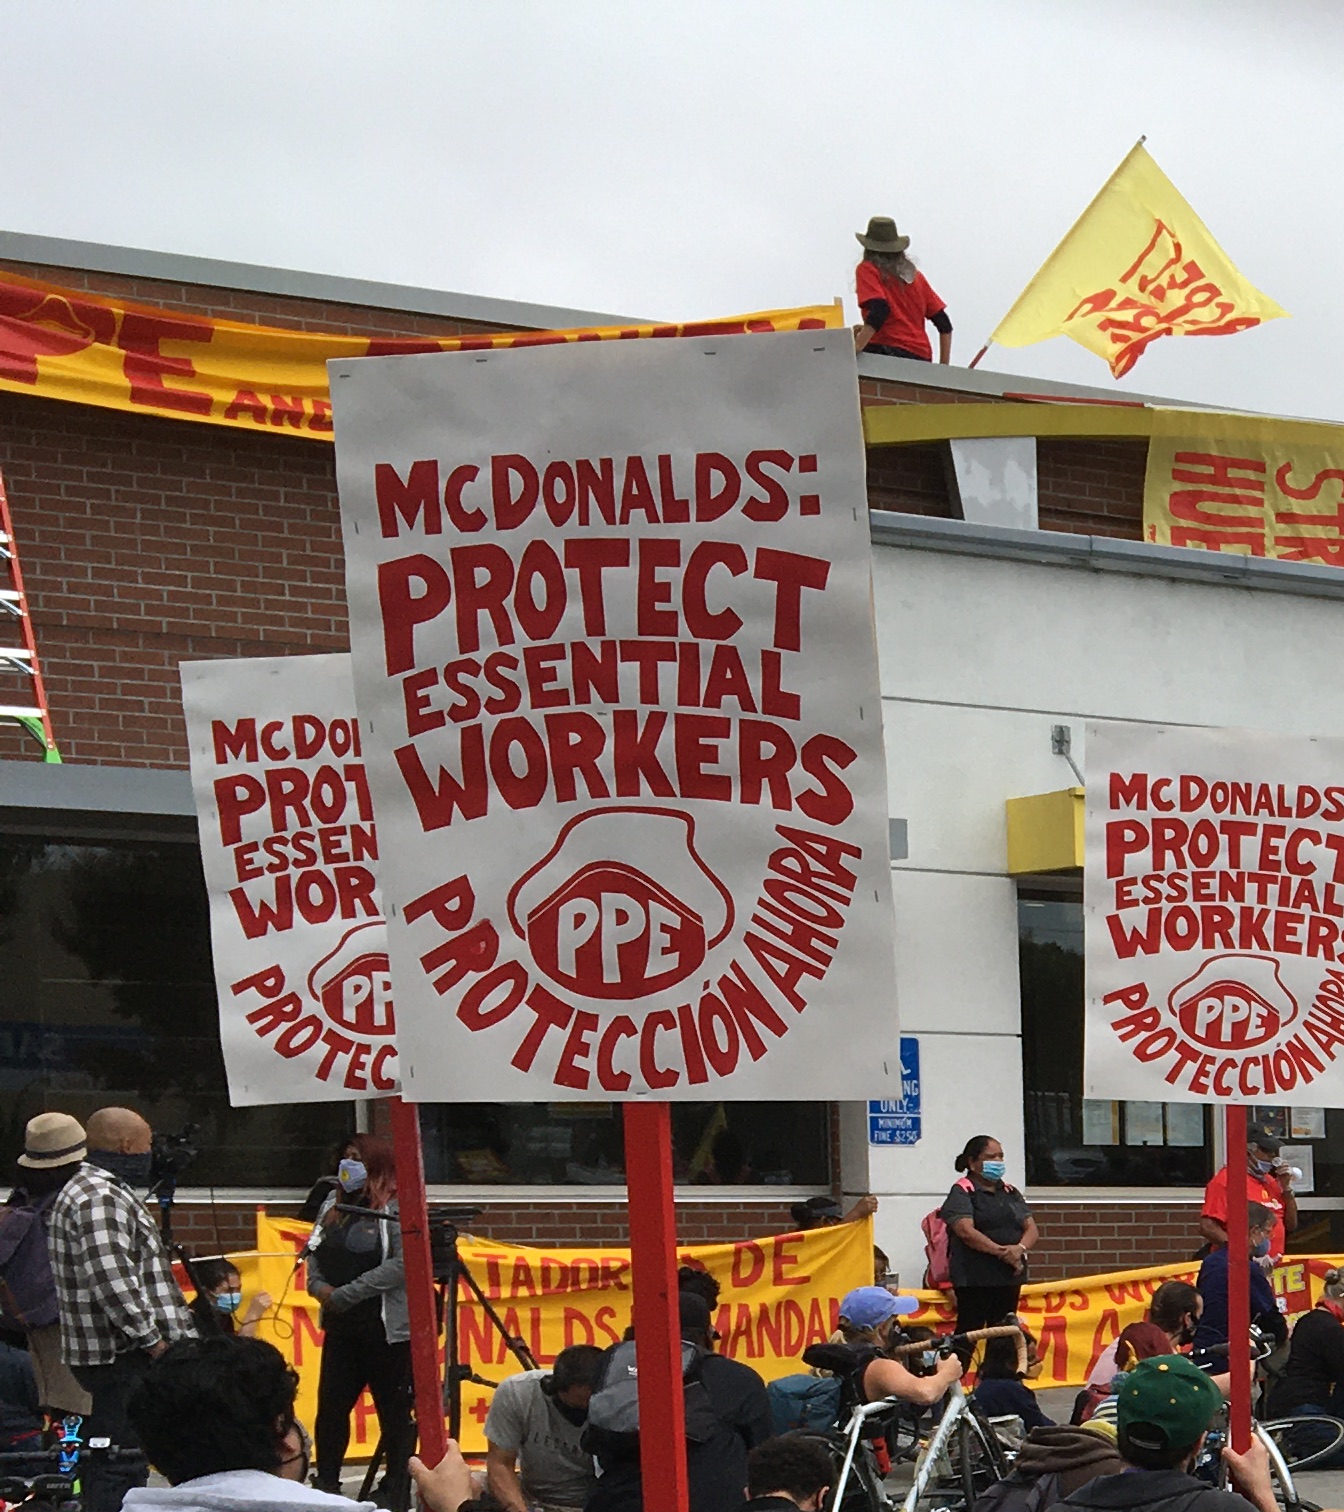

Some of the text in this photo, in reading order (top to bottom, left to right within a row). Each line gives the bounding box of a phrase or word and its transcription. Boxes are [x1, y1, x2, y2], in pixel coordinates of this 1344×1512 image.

[378, 538, 831, 677] PROTECT
[402, 640, 801, 736] ESSENTIAL
[211, 715, 361, 764] McDO
[394, 710, 858, 832] WORKERS
[213, 765, 373, 847] PROT
[234, 823, 379, 883] ESSEN
[742, 825, 863, 1013] AHORA
[1114, 870, 1344, 918] ESSENTIAL
[556, 892, 687, 984] PPE
[230, 964, 398, 1091] PROTEC
[1196, 995, 1268, 1041] PPE
[874, 1131, 891, 1141] FINE
[878, 1118, 912, 1129] MINIMUM
[731, 1234, 811, 1288] DE
